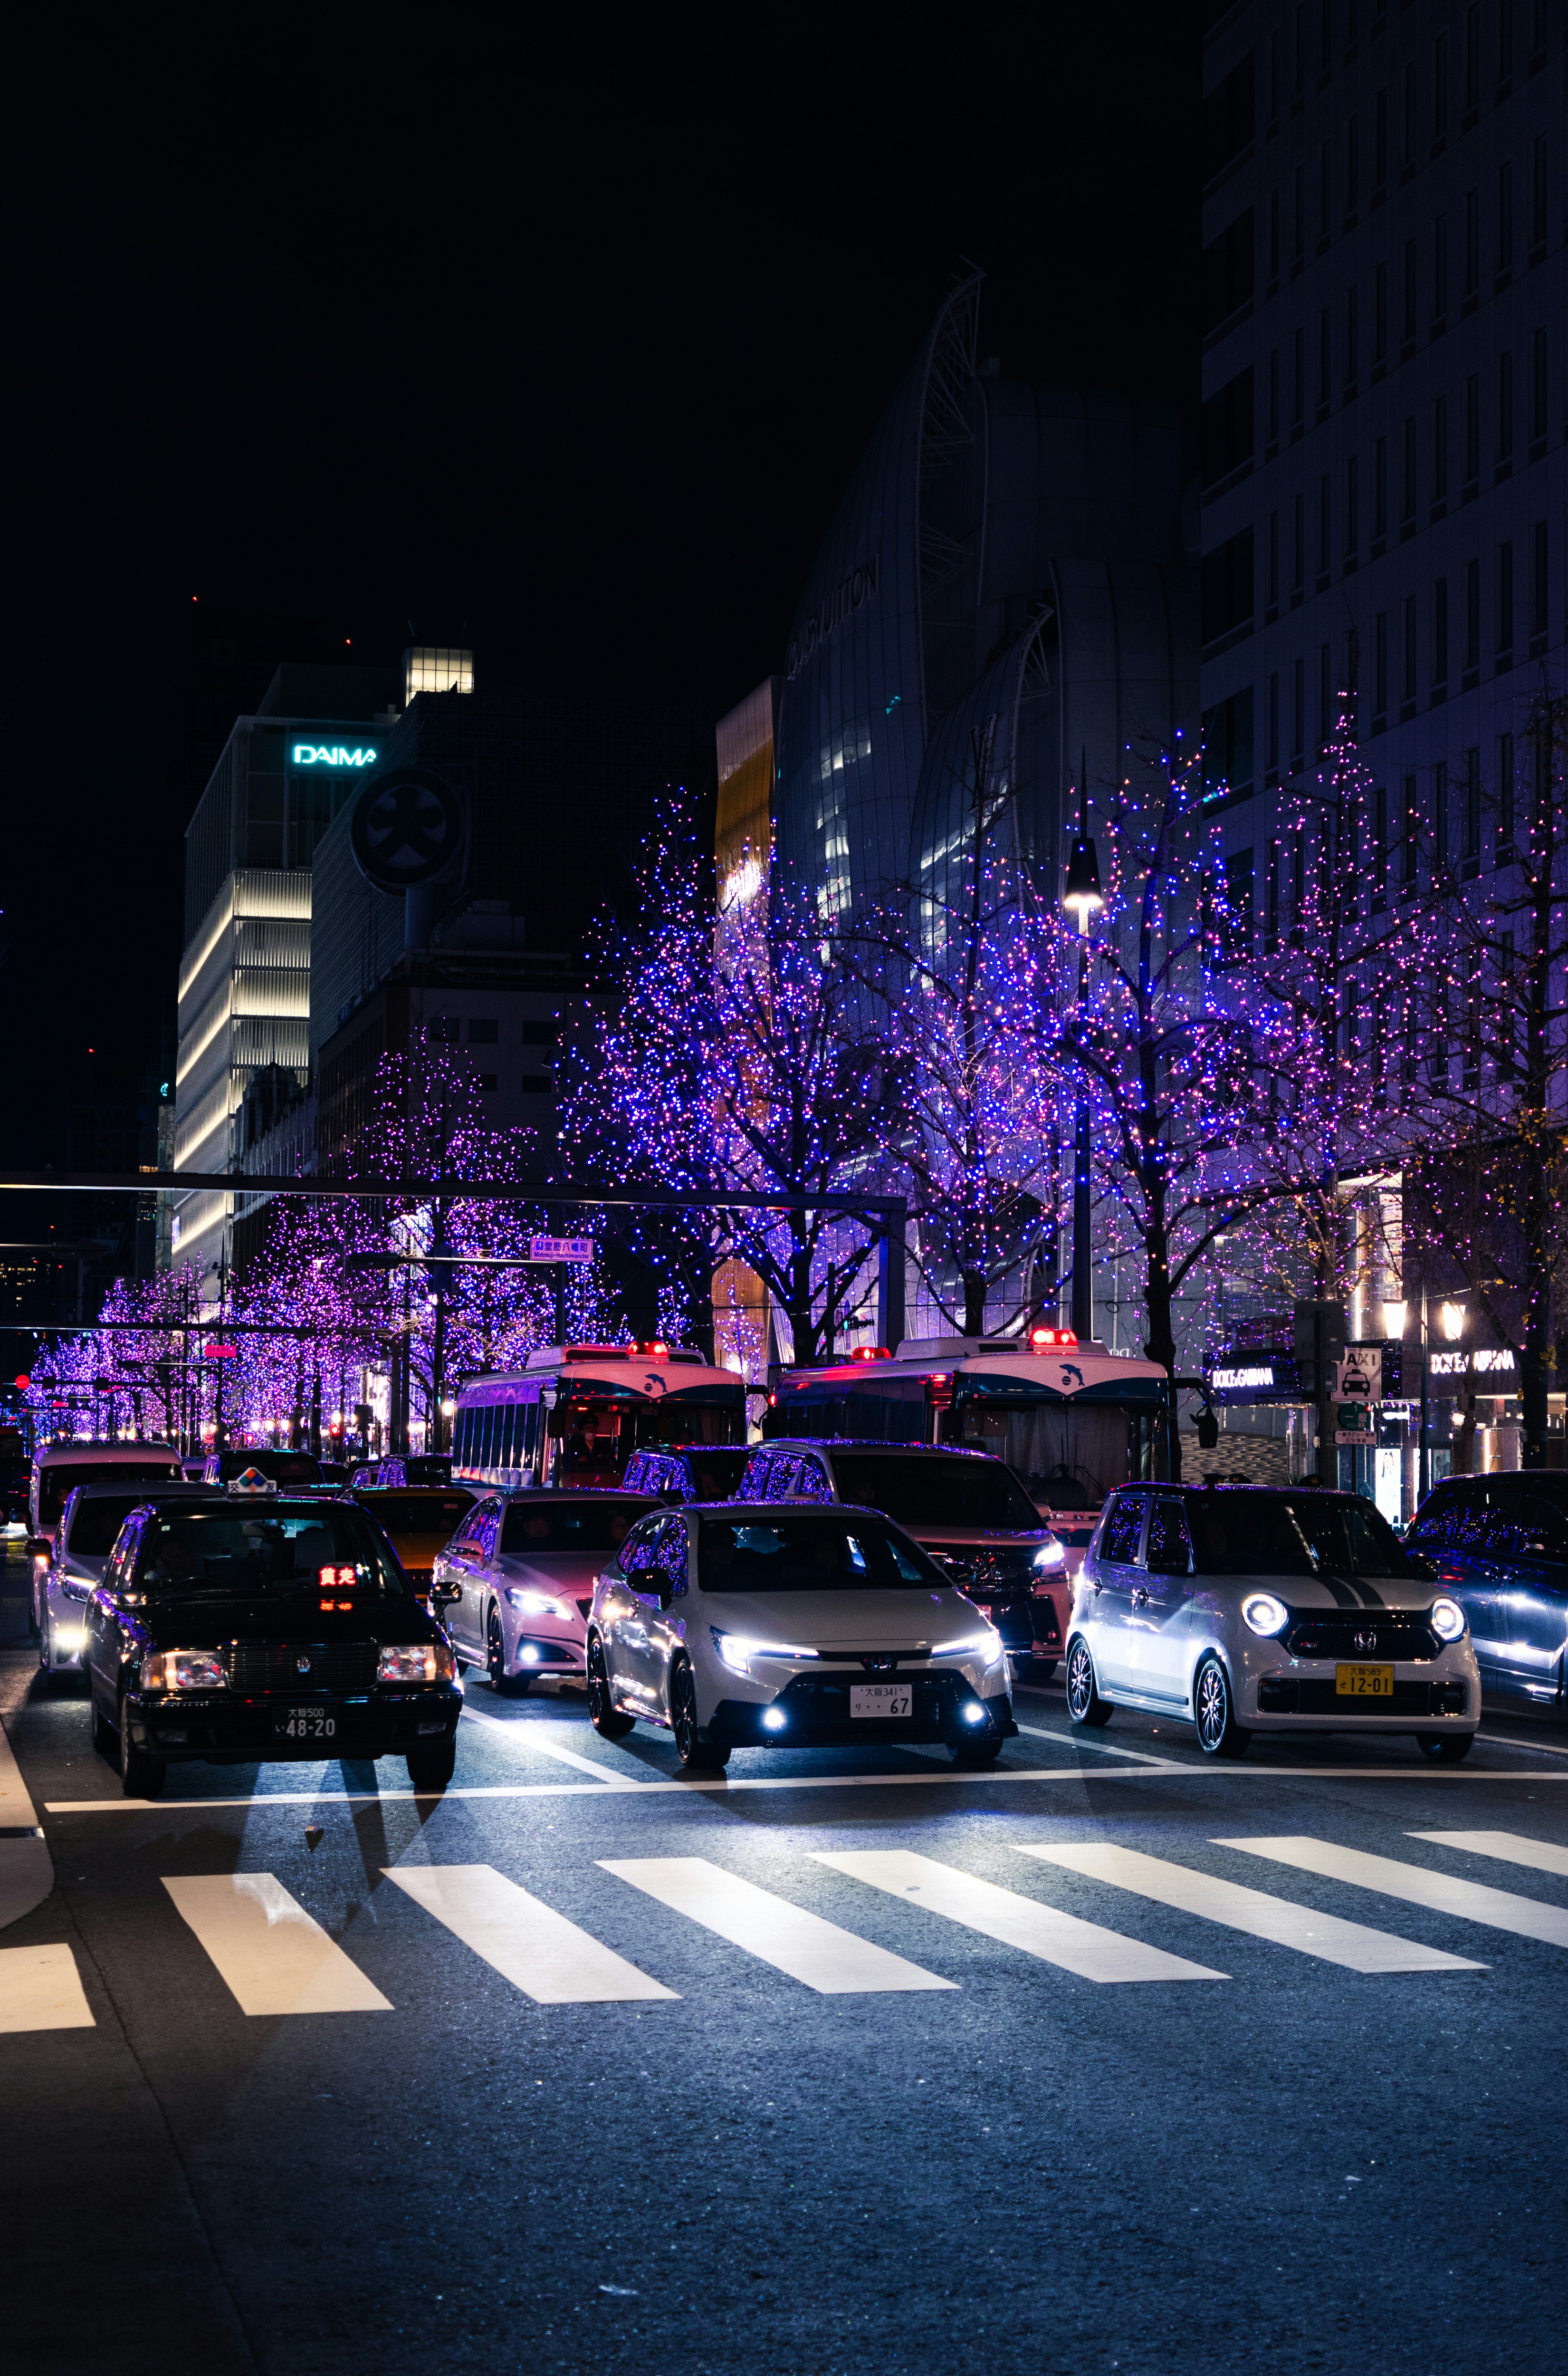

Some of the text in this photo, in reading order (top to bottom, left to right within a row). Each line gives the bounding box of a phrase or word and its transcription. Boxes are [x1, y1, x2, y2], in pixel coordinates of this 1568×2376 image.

[816, 554, 880, 643] VUITTON
[1351, 1677, 1388, 1693] 12-01
[286, 1718, 335, 1737] 48-20
